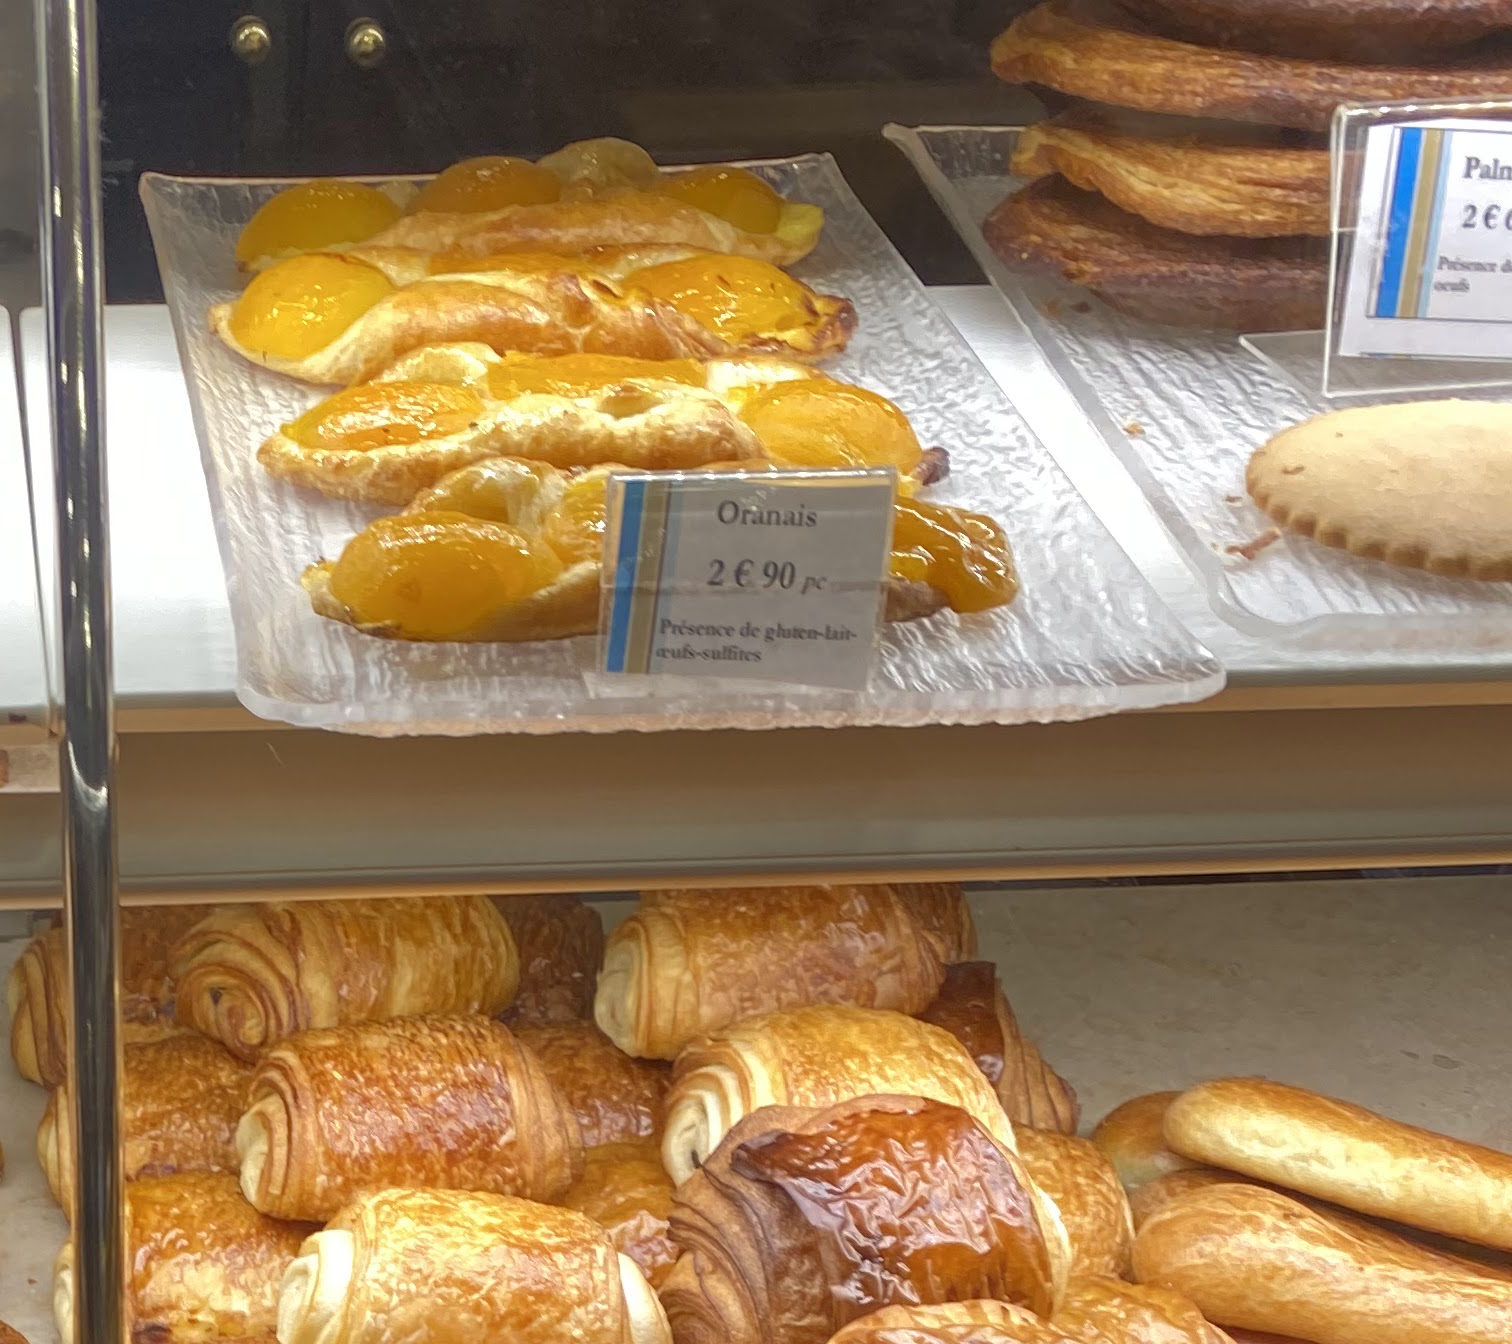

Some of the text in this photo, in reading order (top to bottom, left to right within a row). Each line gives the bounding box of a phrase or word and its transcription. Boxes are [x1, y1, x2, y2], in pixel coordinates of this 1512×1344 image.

[716, 499, 818, 528] Oranais
[659, 617, 736, 638] Présence
[739, 621, 761, 639] de
